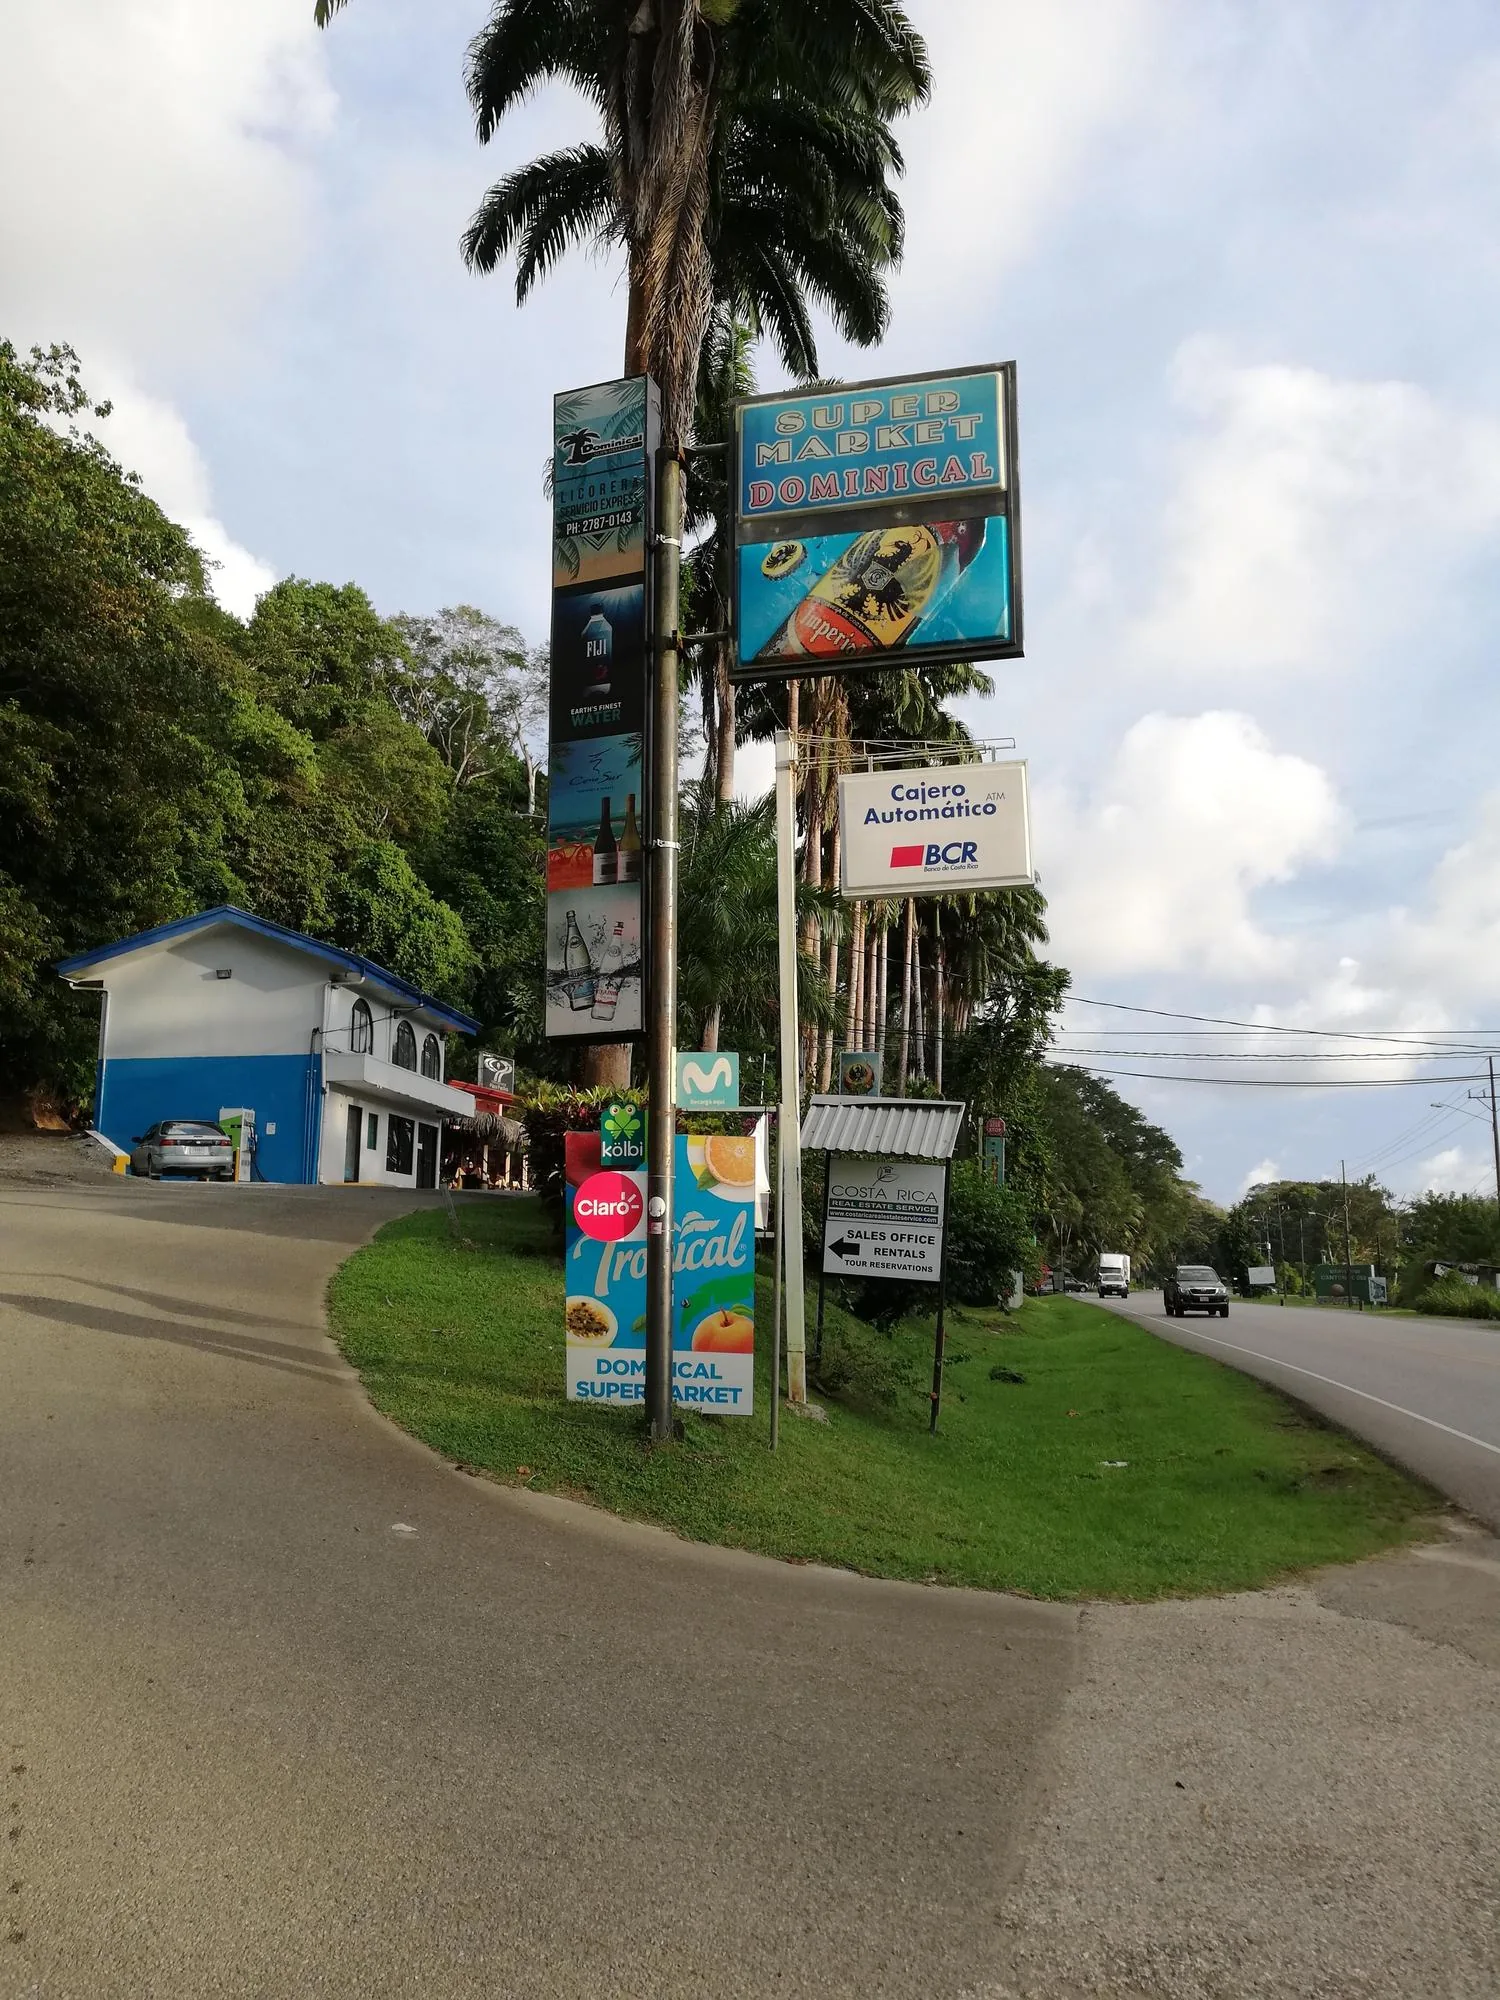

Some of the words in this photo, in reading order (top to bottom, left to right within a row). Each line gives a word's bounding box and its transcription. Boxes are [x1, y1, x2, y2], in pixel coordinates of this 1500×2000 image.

[776, 391, 960, 434] SUPER
[583, 434, 643, 453] Dominical
[757, 415, 981, 466] MARKET
[750, 454, 992, 508] DOMINICAL
[560, 500, 598, 517] SERVICIO
[566, 522, 580, 535] PH:
[582, 511, 632, 532] 2787-0143
[586, 639, 607, 657] FIJI
[570, 706, 597, 715] EARTH'S
[599, 702, 622, 711] FINEST
[571, 709, 620, 727] WATER
[891, 782, 966, 804] Cajero
[985, 792, 1006, 801] ATM
[864, 799, 997, 825] Automático
[925, 842, 978, 865] BCR
[602, 1141, 643, 1157] kölbi
[831, 1185, 887, 1200] COSTA
[897, 1189, 938, 1203] RICA
[577, 1200, 630, 1216] Claro
[832, 1200, 855, 1208] REAL
[859, 1201, 893, 1210] ESTATE
[895, 1203, 937, 1213] SERVICE
[847, 1229, 886, 1241] SALES
[890, 1232, 936, 1245] OFFICE
[873, 1247, 926, 1259] RENTALS
[844, 1259, 867, 1268] TOUR
[869, 1261, 933, 1273] RESERVATIONS
[596, 1359, 723, 1380] DOMICAL
[576, 1381, 742, 1404] SUPERARKET
